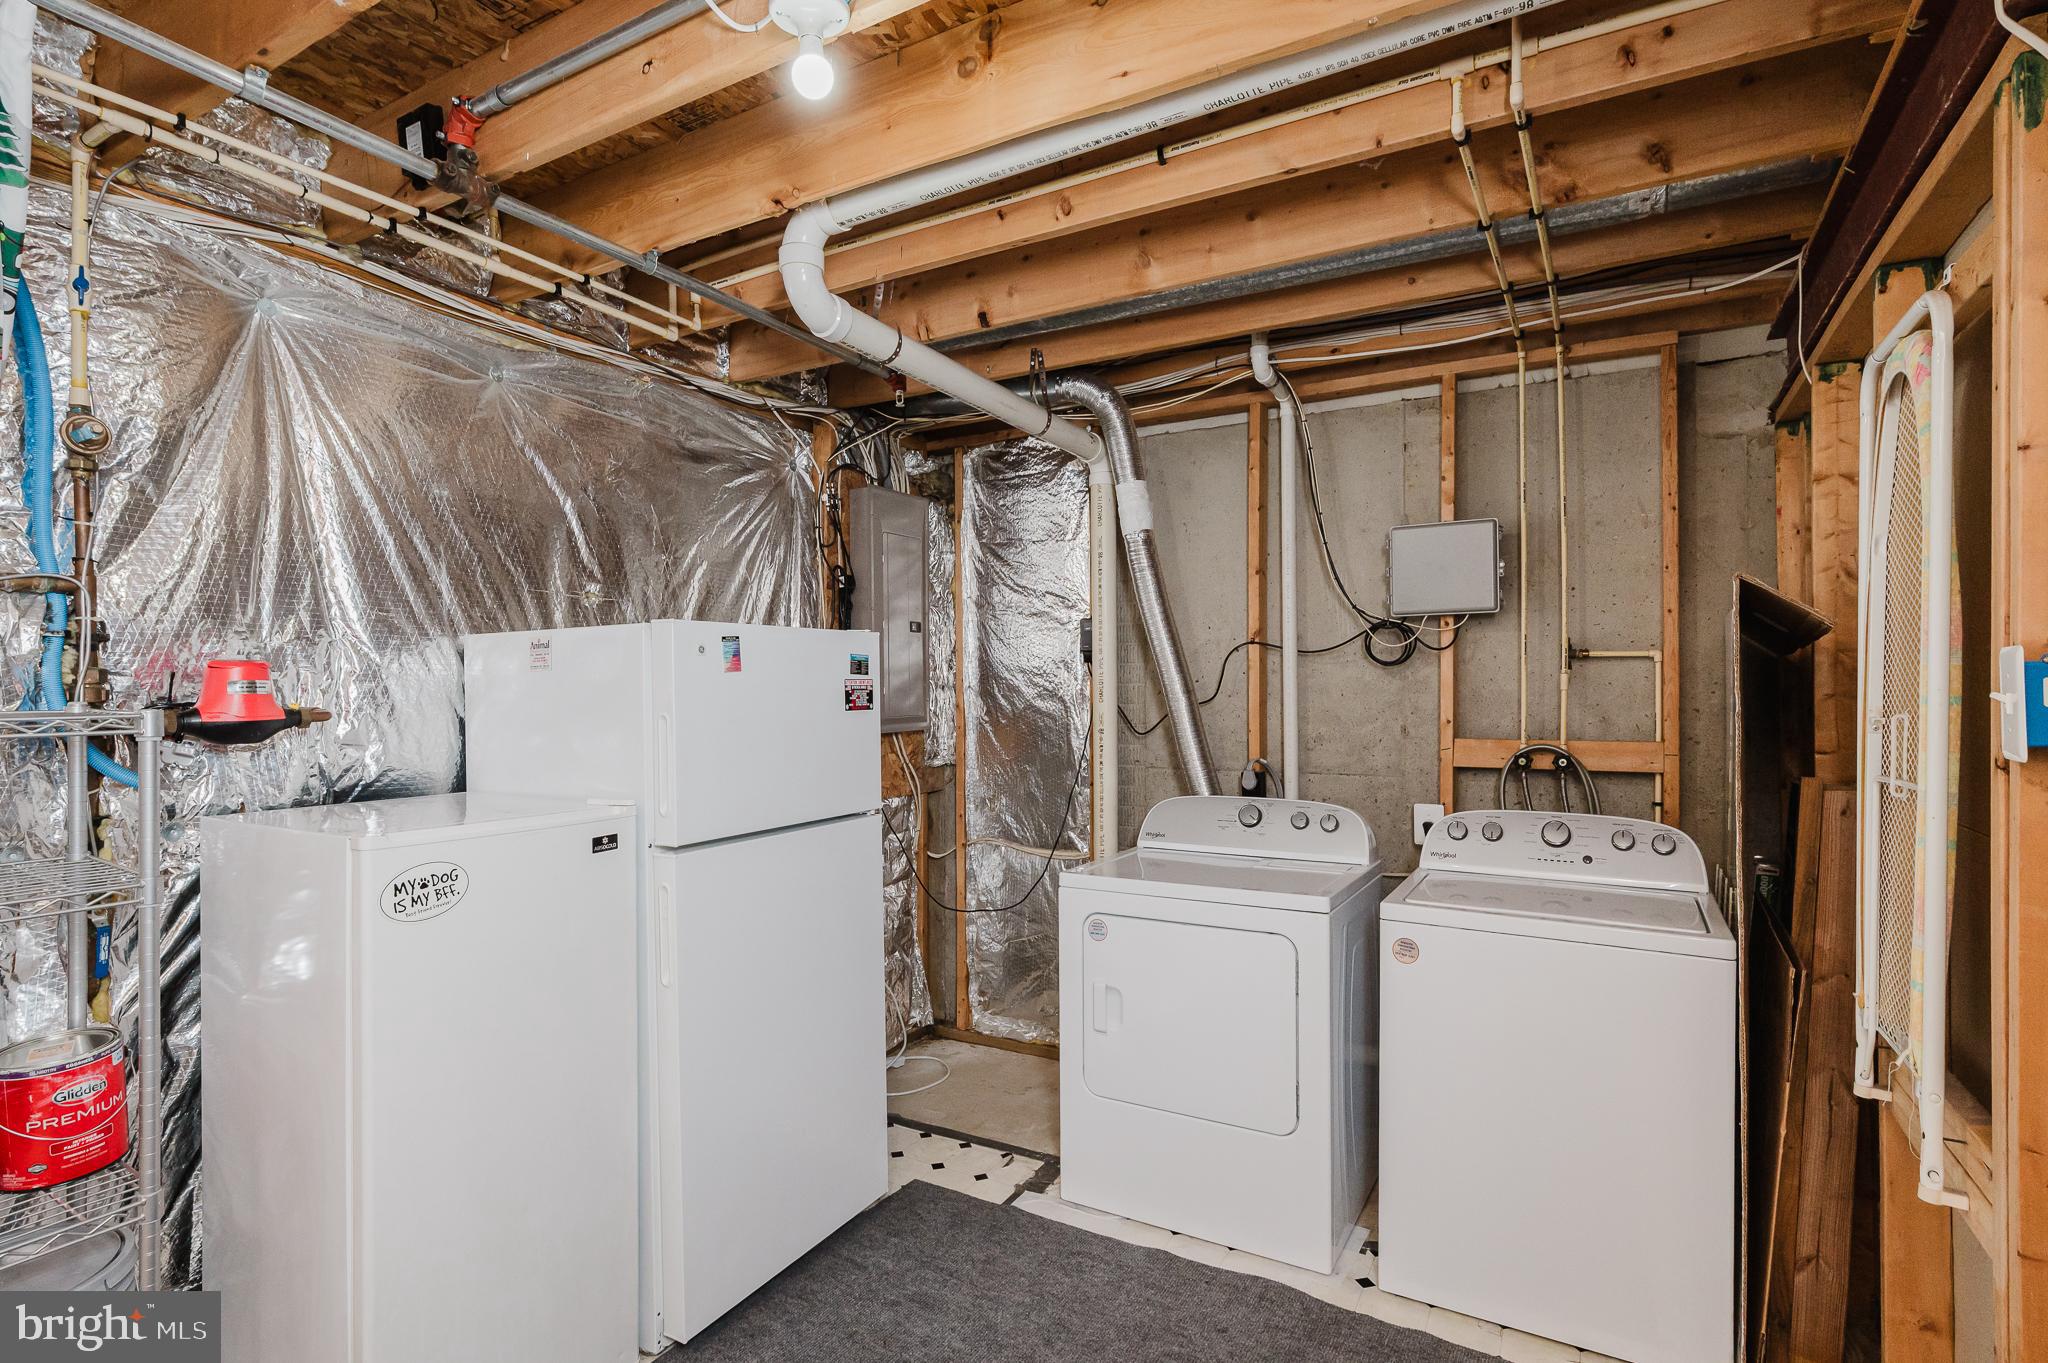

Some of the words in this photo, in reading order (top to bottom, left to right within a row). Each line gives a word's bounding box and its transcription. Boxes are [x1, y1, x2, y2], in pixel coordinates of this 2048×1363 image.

[1203, 86, 1266, 111] CHARLOTTE
[1269, 77, 1294, 91] PIPE
[1377, 41, 1408, 56] CELLULAR
[1410, 34, 1426, 45] CORE
[1427, 30, 1440, 38] PVC
[1457, 19, 1473, 28] PIPE
[1474, 13, 1493, 24] ASTM
[919, 183, 967, 201] CHARLOTTE
[968, 176, 987, 187] PIPE
[393, 878, 416, 898] MY
[430, 868, 459, 887] DOG
[393, 898, 407, 914] IS
[411, 891, 430, 908] MY
[54, 1080, 107, 1103] Glidden
[26, 1091, 122, 1133] PREMIUM
